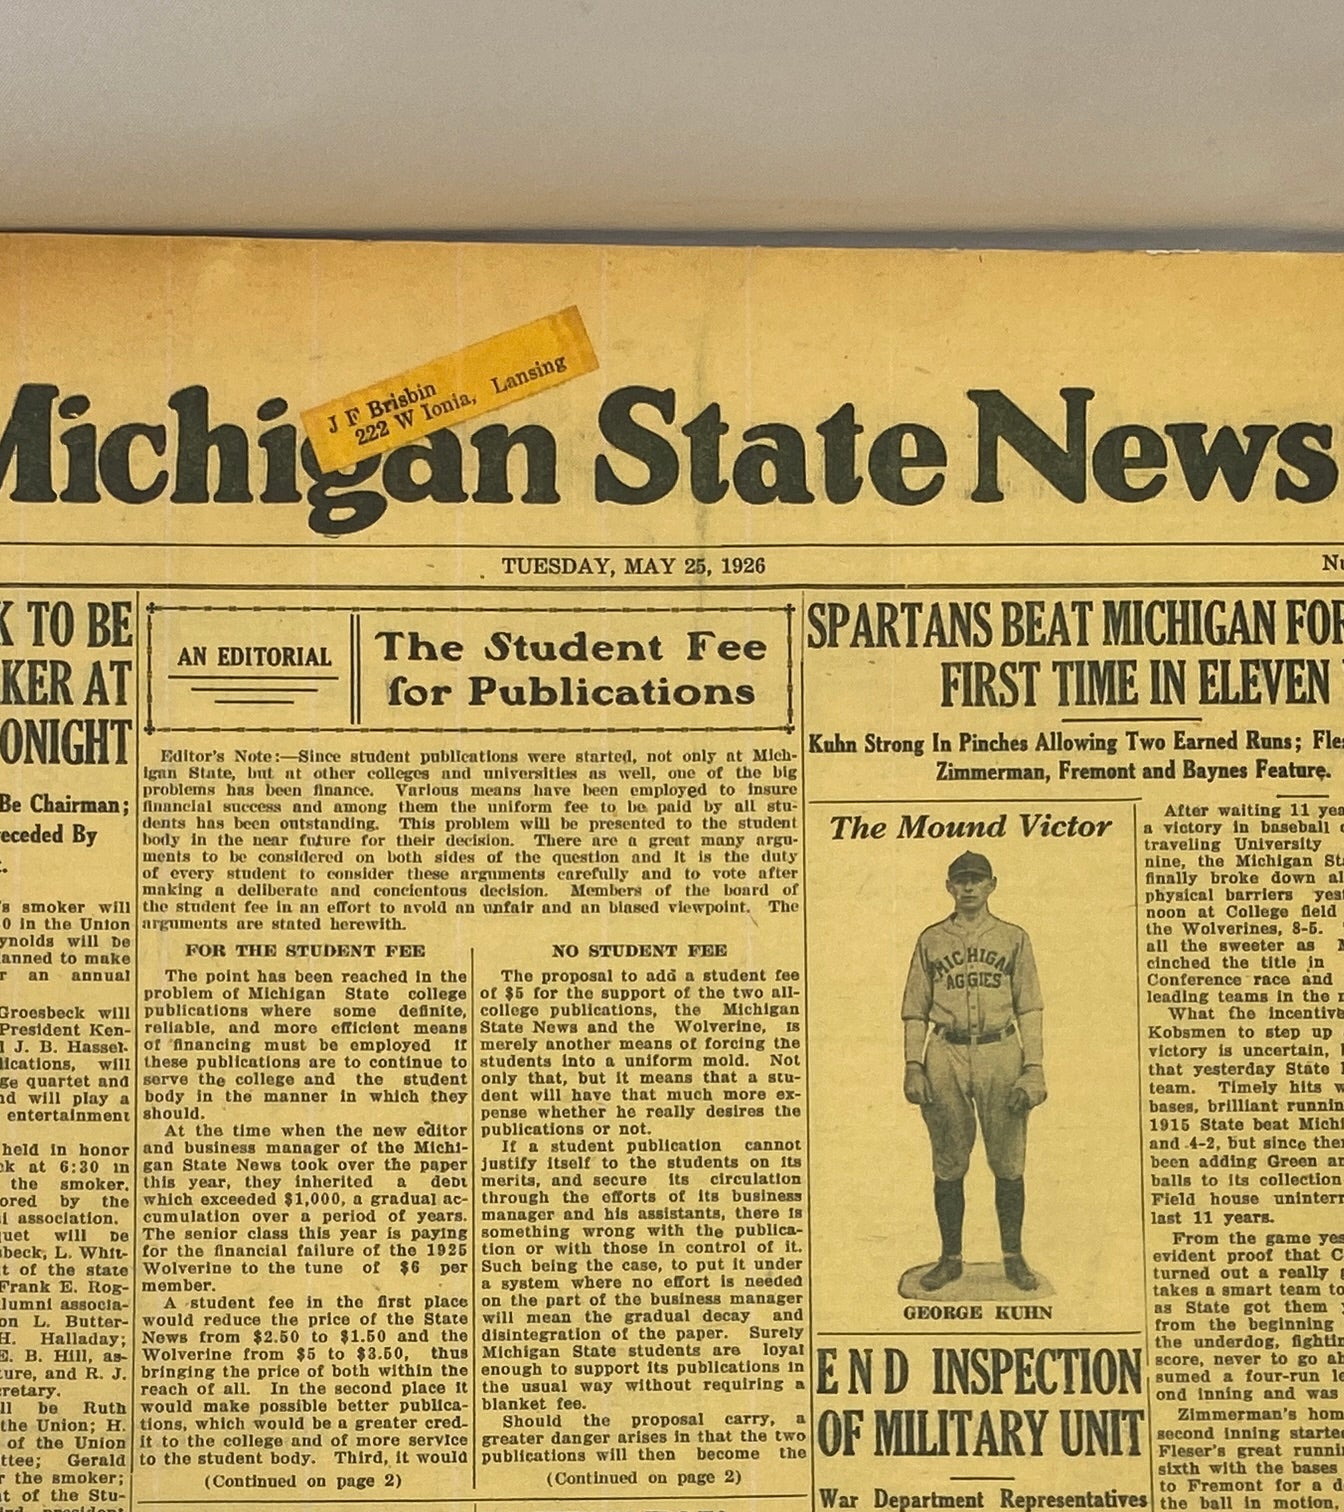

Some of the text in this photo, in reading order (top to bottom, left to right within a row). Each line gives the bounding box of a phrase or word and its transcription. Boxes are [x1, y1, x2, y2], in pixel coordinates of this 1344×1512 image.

[326, 383, 438, 434] J F Brisbin
[354, 355, 568, 447] 222 W Ionia, Lansing
[595, 385, 947, 507] State
[965, 386, 1340, 507] News
[501, 556, 766, 579] TUESDAY, MAY 25, 1926
[26, 600, 75, 648] TO
[86, 600, 134, 648] BE
[807, 600, 994, 650] SPARTANS
[1000, 600, 1094, 648] BEAT
[1101, 599, 1277, 647] MICHIGAN
[176, 645, 333, 667] AN EDITORIAL
[374, 630, 768, 662] The Student Fee
[82, 659, 133, 707] AT
[385, 675, 756, 707] for Publications
[940, 660, 1042, 709] FIRST
[1051, 658, 1140, 707] TIME
[1148, 658, 1187, 706] IN
[1197, 658, 1331, 706] ELEVEN
[808, 732, 859, 754] Kuhn
[864, 732, 926, 758] Strong
[932, 731, 953, 753] In
[958, 731, 1029, 753] Pinches
[1034, 730, 1119, 756] Allowing
[1124, 730, 1166, 752] Two
[1173, 729, 1239, 751] Earned
[1245, 729, 1302, 754] Runs;
[935, 758, 1332, 785] Zimmerman, Fremont and Baynes Feature.
[29, 792, 129, 817] Chairman;
[1163, 803, 1210, 818] After
[1217, 803, 1282, 819] waiting
[1290, 802, 1310, 817] 11
[71, 823, 99, 848] By
[829, 813, 1114, 841] The Mound Victor
[21, 900, 86, 914] smoker
[97, 900, 131, 914] will
[141, 916, 407, 932] arguments are stated herewith.
[184, 943, 426, 958] FOR THE STUDENT FEE
[551, 943, 728, 959] NO STUDENT FEE
[946, 971, 1003, 991] AGGIES
[903, 1305, 1053, 1321] GEORGE KUHN
[931, 1347, 1143, 1396] INSPECTION
[816, 1408, 1145, 1458] OF MILITARY UNIT
[818, 1487, 859, 1509] War
